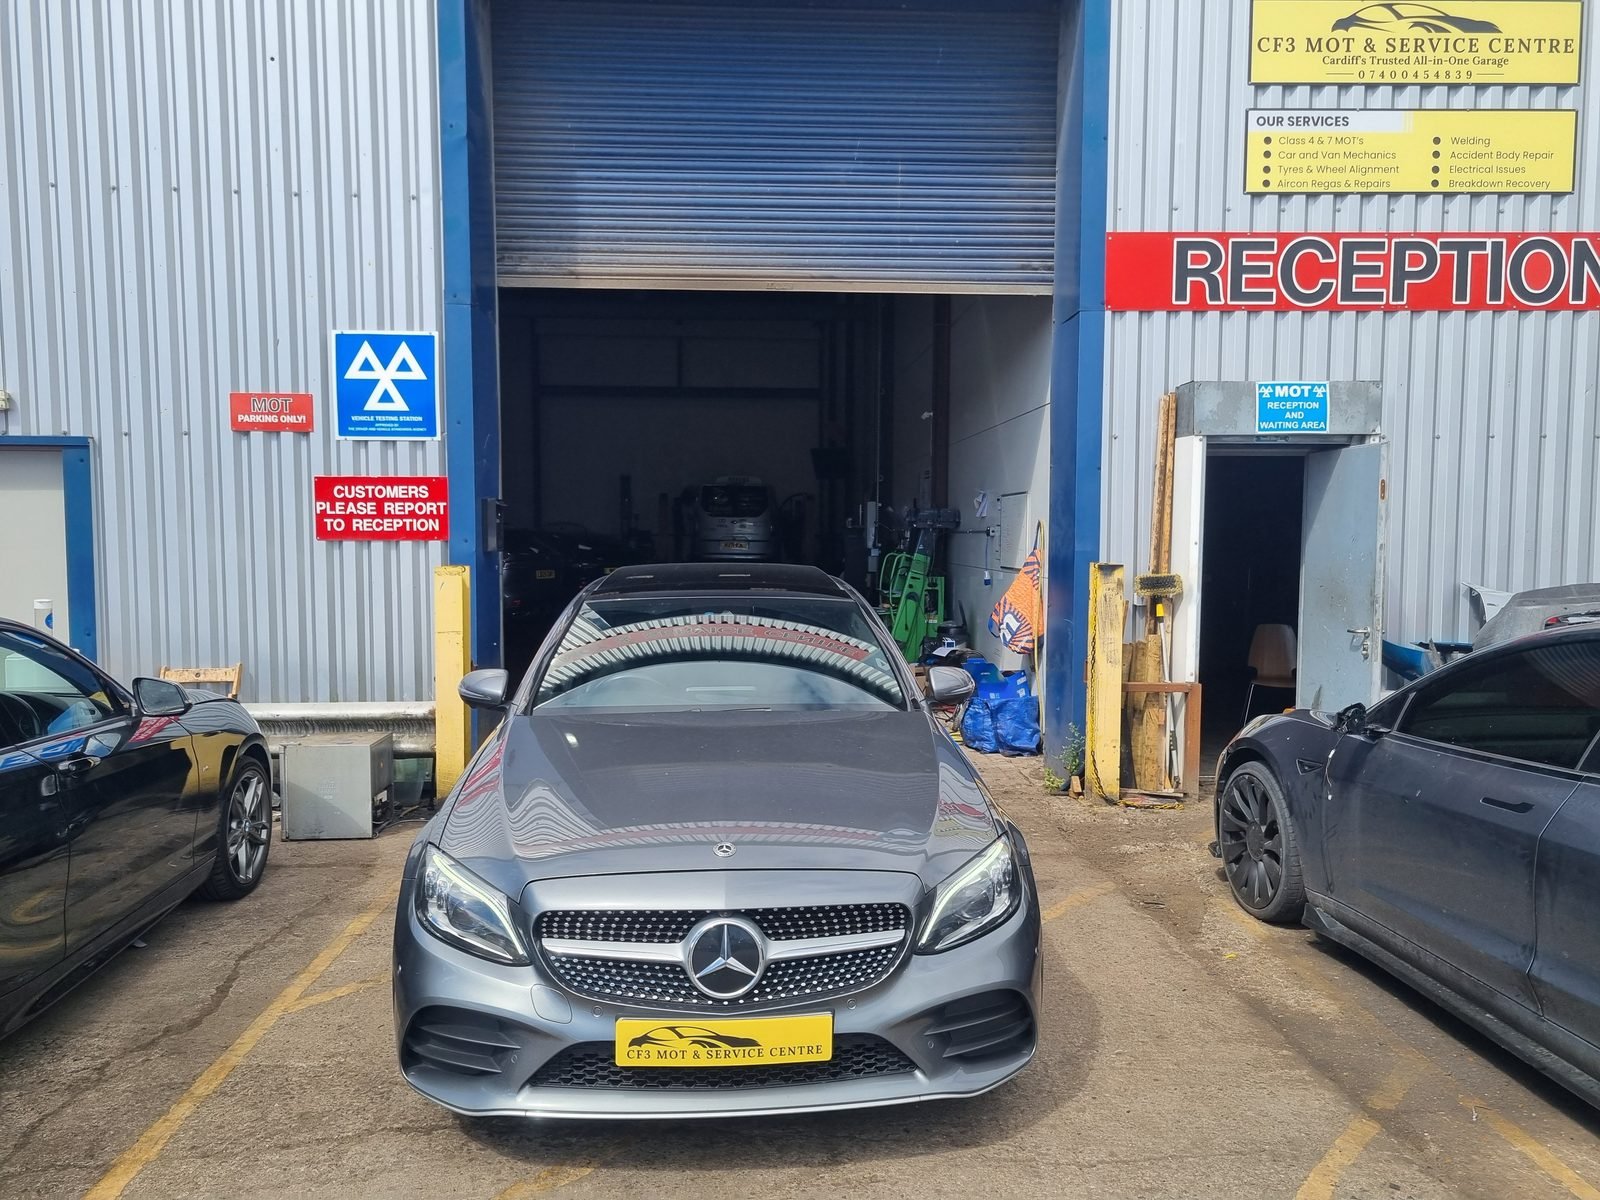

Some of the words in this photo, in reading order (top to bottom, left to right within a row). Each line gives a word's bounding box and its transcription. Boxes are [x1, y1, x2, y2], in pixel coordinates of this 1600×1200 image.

[1257, 37, 1296, 53] CF3
[1305, 37, 1355, 53] MOT
[1363, 37, 1377, 53] &
[1385, 37, 1479, 53] SERVICE
[1488, 38, 1575, 54] CENTRE
[1322, 55, 1367, 65] Cardiff's
[1369, 55, 1411, 65] Trusted
[1413, 55, 1470, 66] All-in-One
[1472, 55, 1509, 68] Garage
[1358, 70, 1473, 80] 07400454839
[1256, 116, 1284, 127] OUR
[1287, 116, 1350, 127] SERVICES
[1278, 136, 1306, 145] Class
[1308, 136, 1315, 145] 4
[1316, 136, 1325, 145] &
[1327, 136, 1333, 145] 7
[1335, 136, 1364, 145] MOT's
[1450, 136, 1491, 147] Welding
[1278, 151, 1296, 160] Car
[1298, 151, 1319, 160] and
[1320, 151, 1341, 160] Van
[1343, 150, 1397, 160] Mechanics
[1450, 151, 1494, 160] Accident
[1495, 151, 1521, 161] Body
[1522, 151, 1555, 161] Repair
[1278, 165, 1304, 176] Tyres
[1305, 165, 1313, 174] &
[1315, 165, 1347, 174] Wheel
[1349, 165, 1400, 176] Alignment
[1449, 165, 1494, 174] Electrical
[1496, 165, 1526, 174] Issues
[1277, 179, 1309, 188] Aircon
[1311, 180, 1342, 190] Regas
[1343, 180, 1352, 188] &
[1354, 180, 1391, 190] Repairs
[1448, 179, 1504, 188] Breakdown
[1505, 180, 1551, 190] Recovery
[1171, 236, 1600, 306] RECEPTION
[1275, 385, 1312, 398] MOT
[251, 397, 292, 413] MOT
[1267, 401, 1319, 410] RECEPTION
[238, 414, 279, 424] PARKING
[280, 414, 306, 424] ONLY!
[1284, 411, 1305, 419] AND
[1260, 421, 1299, 429] WAITING
[1300, 421, 1326, 429] AREA
[333, 485, 429, 499] CUSTOMERS
[316, 502, 377, 515] PLEASE
[384, 502, 447, 515] REPORT
[323, 518, 345, 531] TO
[352, 518, 440, 532] RECEPTION
[626, 1049, 651, 1060] CF3
[656, 1049, 688, 1060] MOT
[692, 1049, 701, 1060] &
[706, 1047, 764, 1060] SERVICE
[769, 1044, 823, 1057] CENTRE
